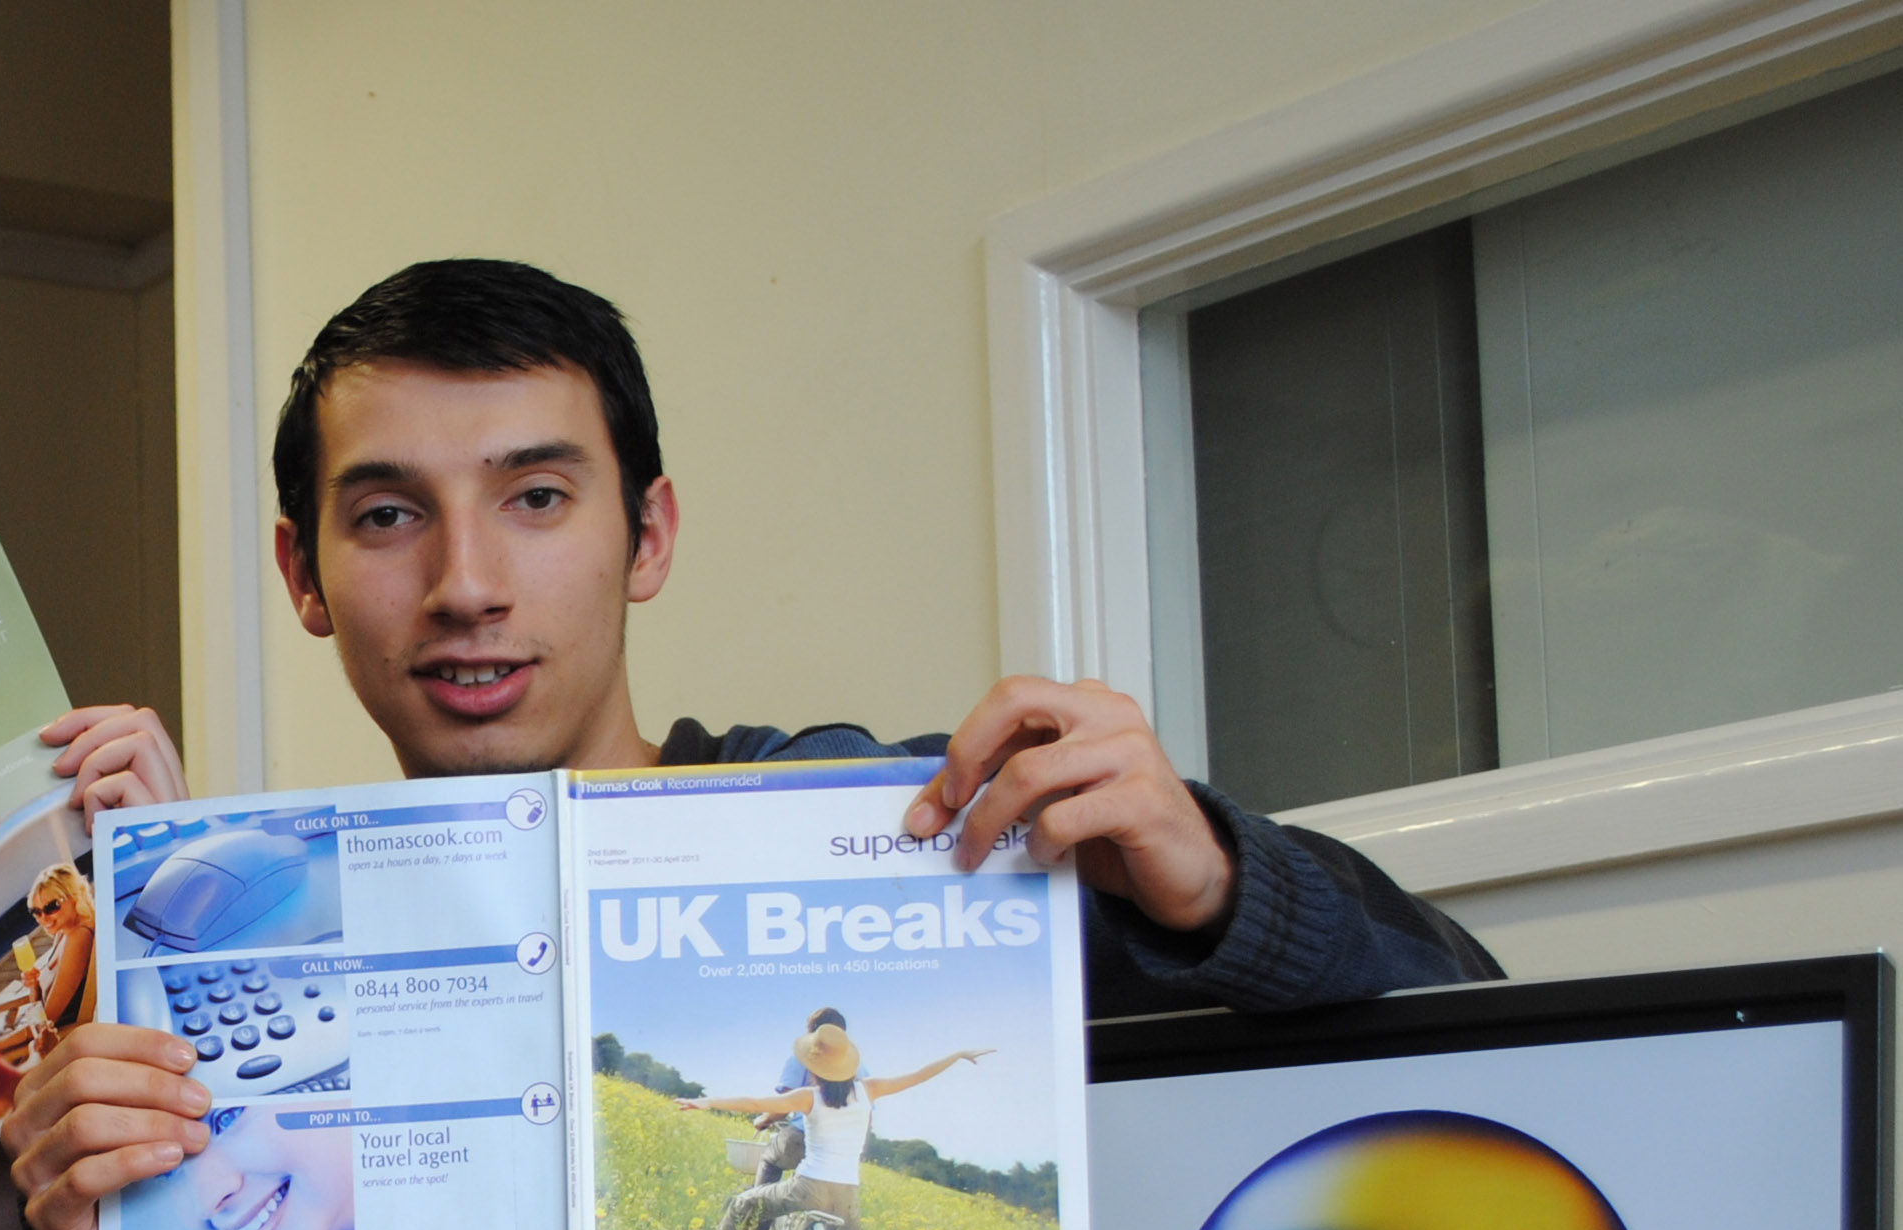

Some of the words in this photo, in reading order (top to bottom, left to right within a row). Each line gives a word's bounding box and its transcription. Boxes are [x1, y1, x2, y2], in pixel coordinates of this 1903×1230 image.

[580, 781, 628, 793] Thomas
[632, 779, 662, 791] Cook
[667, 774, 762, 789] Recommended
[294, 816, 327, 830] CLICK
[331, 815, 350, 828] ON
[353, 814, 379, 826] TO...
[347, 828, 502, 854] thomascook.com
[829, 825, 1028, 861] superbak
[387, 857, 412, 868] hours
[452, 853, 473, 864] days
[599, 894, 724, 962] UK
[747, 884, 1042, 957] Breaks
[302, 961, 330, 974] CALL
[334, 959, 373, 972] NOW...
[699, 964, 732, 978] Over
[737, 963, 775, 978] 2,000
[780, 962, 822, 975] hotels
[827, 961, 839, 973] in
[844, 960, 869, 972] 450
[874, 958, 940, 971] locations
[354, 979, 399, 998] 0844
[406, 977, 440, 994] 800
[446, 975, 488, 993] 7034
[356, 1001, 396, 1016] personal
[398, 1001, 428, 1012] service
[430, 998, 452, 1012] from
[455, 997, 469, 1008] the
[471, 995, 504, 1008] experts
[506, 994, 516, 1004] in
[518, 992, 543, 1003] travel
[309, 1113, 333, 1125] POP
[337, 1112, 350, 1123] IN
[354, 1111, 381, 1122] TO...
[360, 1132, 401, 1149] Your
[409, 1127, 450, 1147] local
[361, 1149, 411, 1169] travel
[419, 1147, 469, 1169] agent
[362, 1177, 392, 1188] service
[395, 1178, 407, 1186] on
[409, 1175, 424, 1185] the
